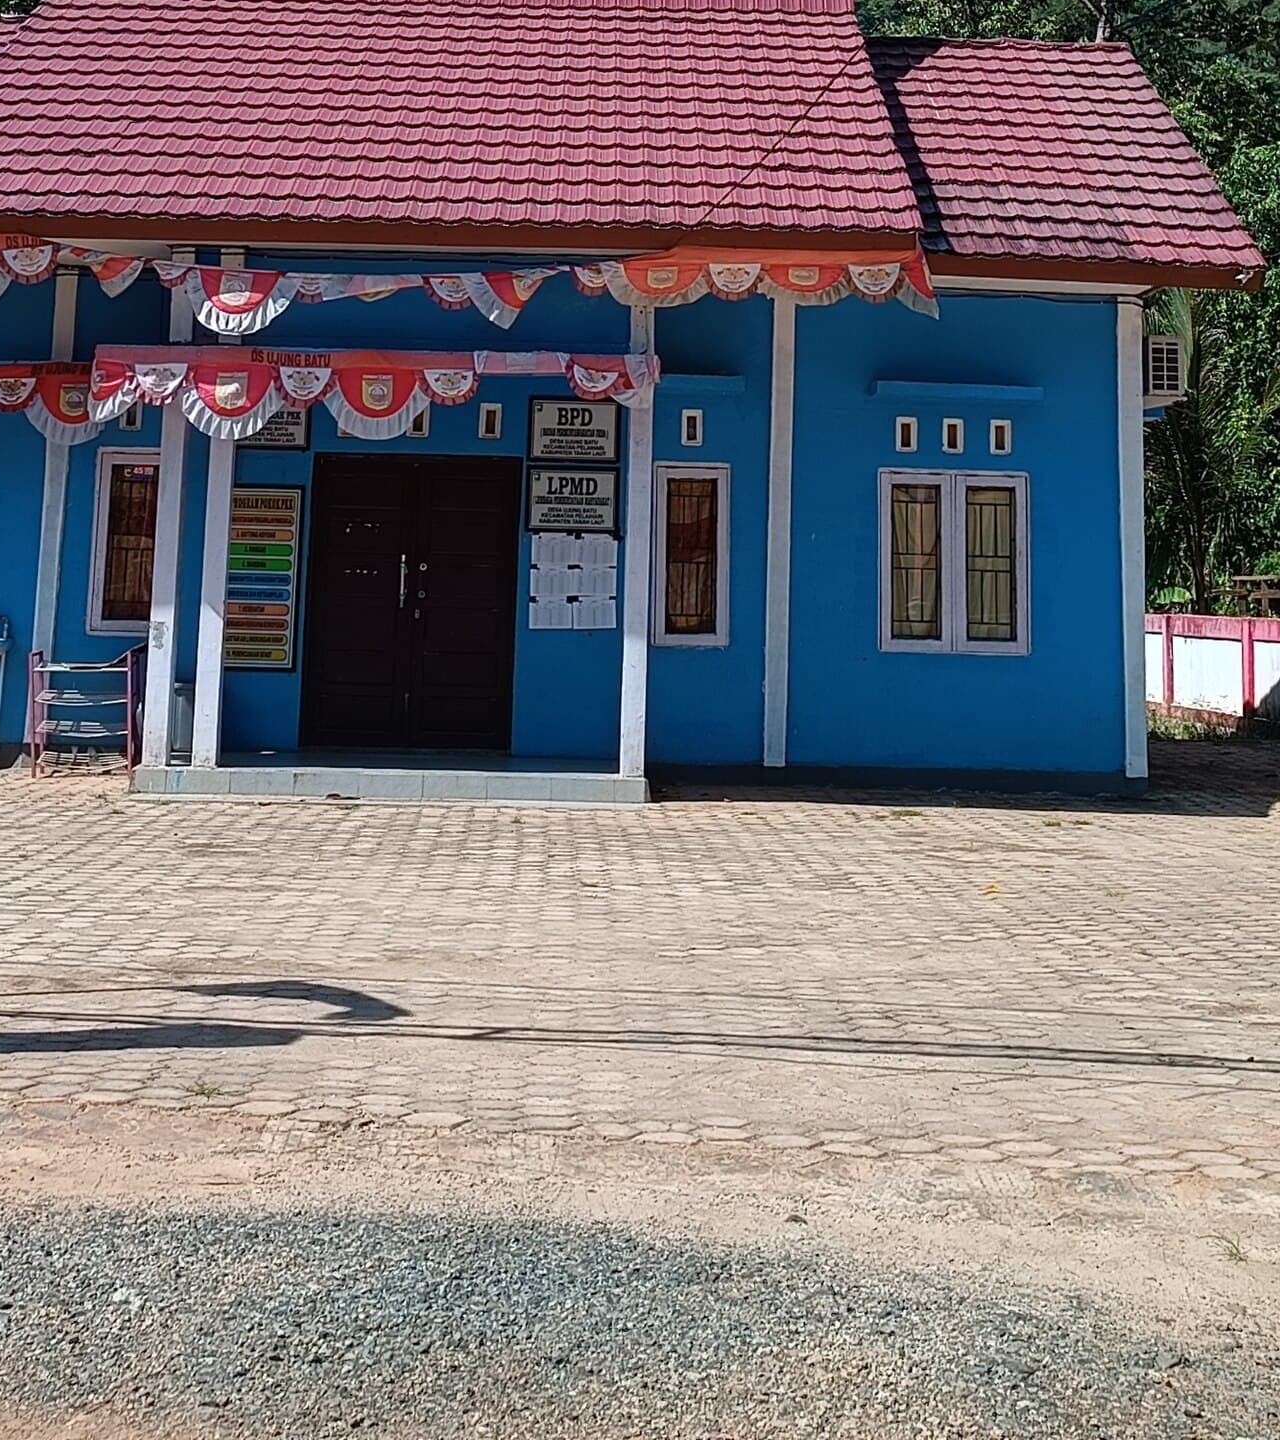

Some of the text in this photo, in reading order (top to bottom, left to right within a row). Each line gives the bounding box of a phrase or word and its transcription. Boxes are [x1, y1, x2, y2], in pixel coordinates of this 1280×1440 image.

[267, 352, 301, 367] UJUNG
[304, 354, 331, 368] BATU
[557, 408, 593, 427] BPD
[547, 476, 598, 496] LPMD
